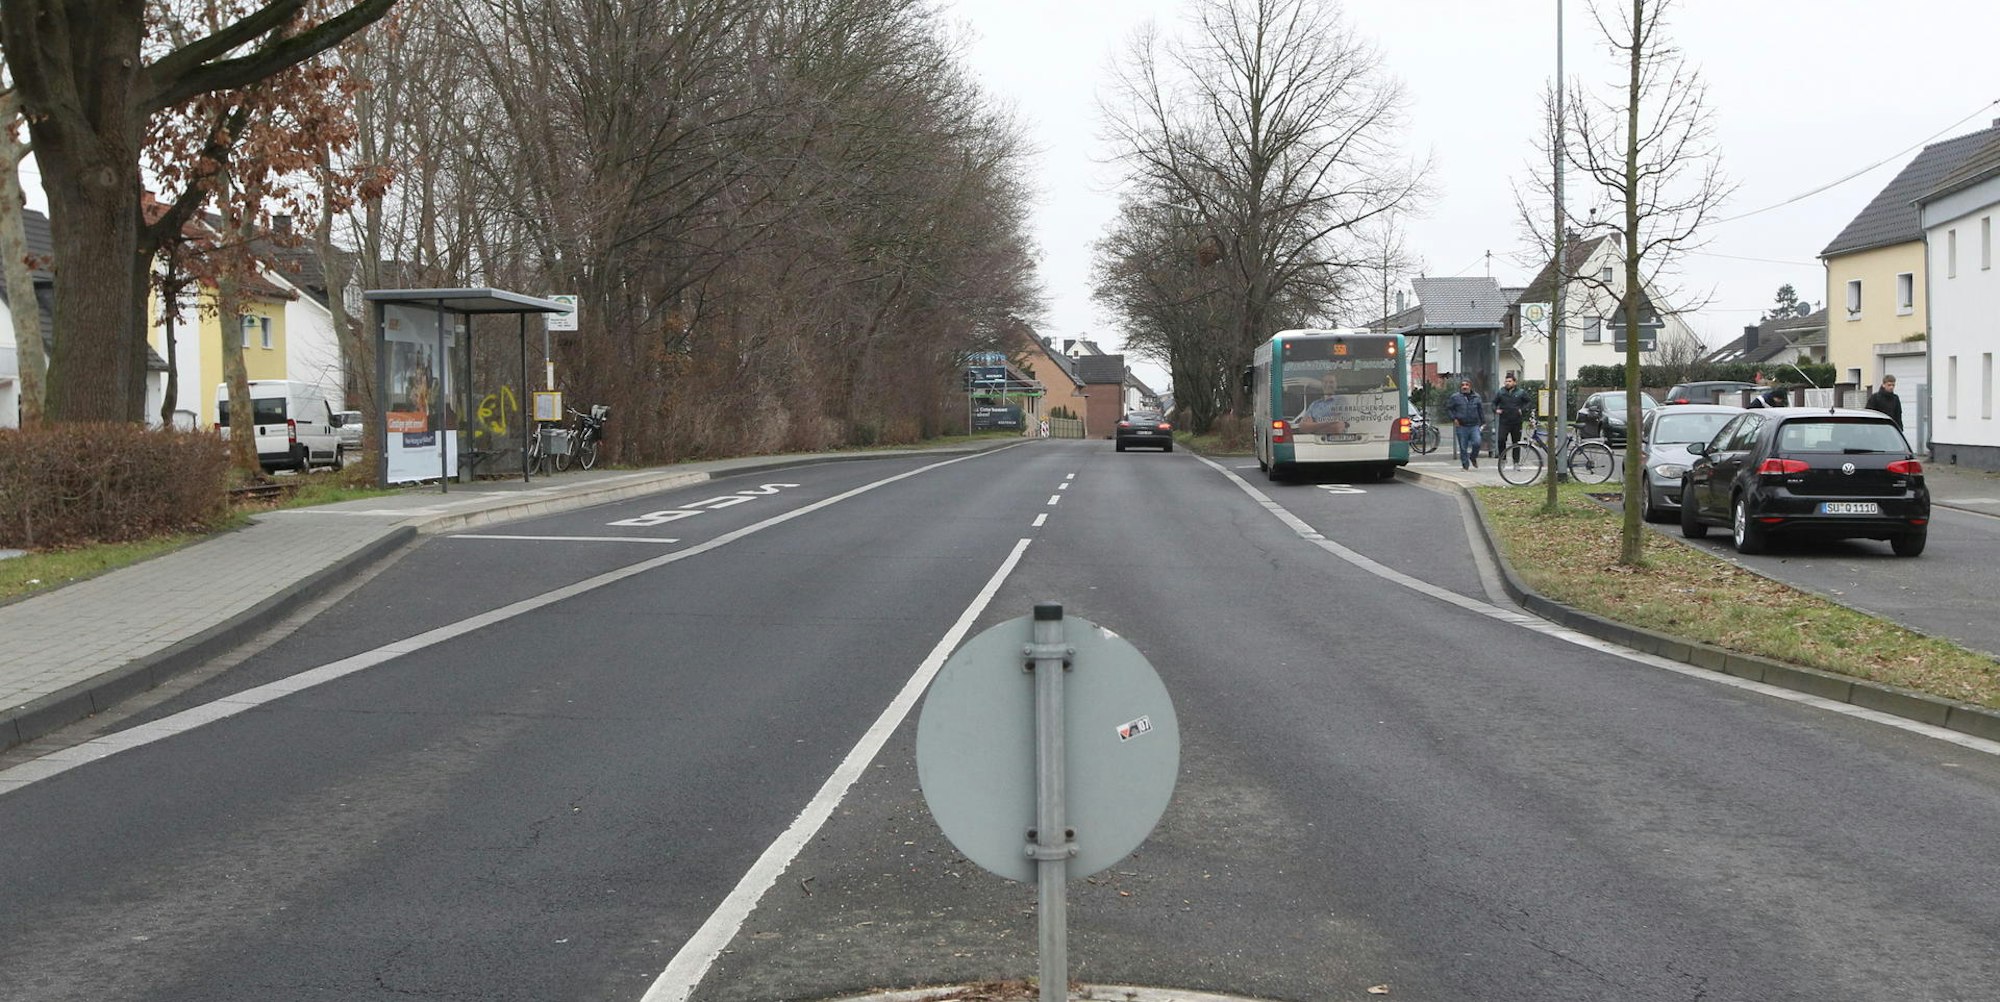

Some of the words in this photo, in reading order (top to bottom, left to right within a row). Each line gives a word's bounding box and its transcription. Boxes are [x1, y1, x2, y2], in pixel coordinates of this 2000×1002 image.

[605, 483, 801, 526] BUS
[1827, 503, 1839, 512] SU
[1854, 503, 1877, 512] 1110
